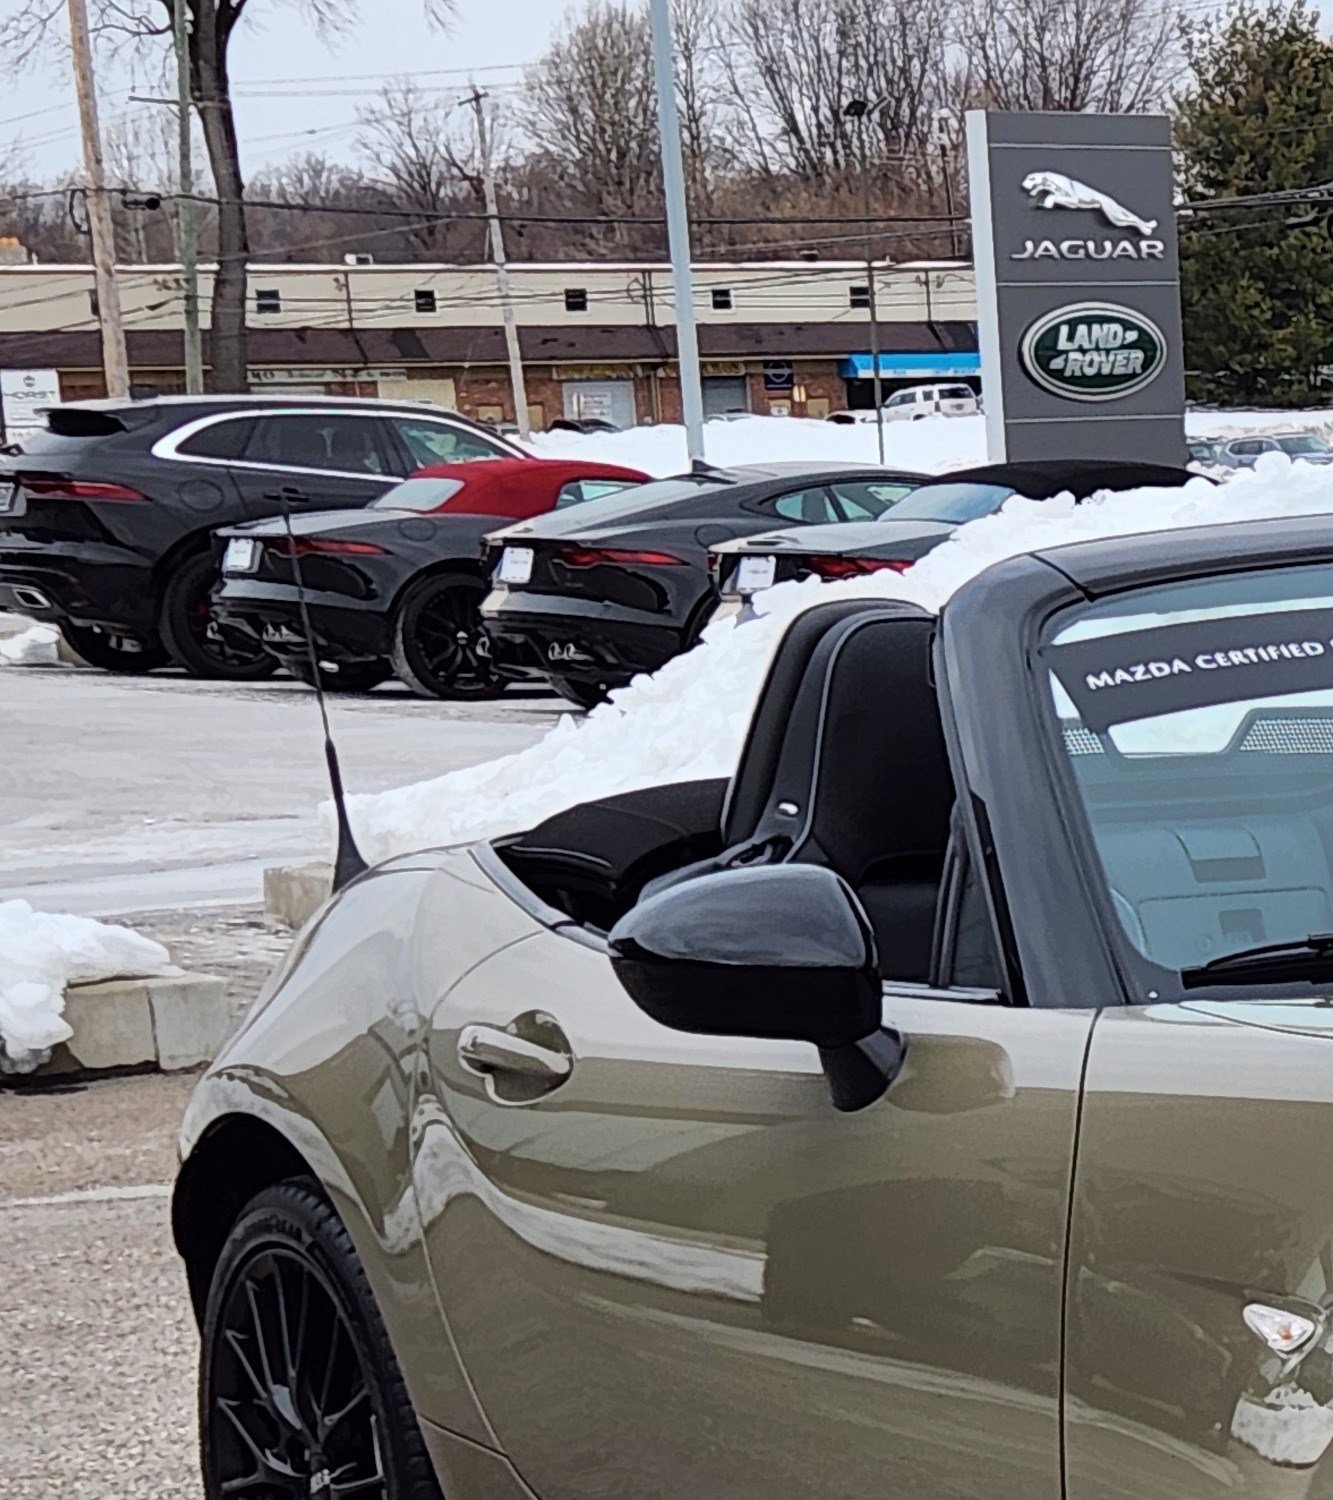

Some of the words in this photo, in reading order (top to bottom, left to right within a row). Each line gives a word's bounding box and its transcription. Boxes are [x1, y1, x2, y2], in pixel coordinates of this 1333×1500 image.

[1011, 240, 1164, 259] JAGUAR
[1057, 323, 1124, 350] LAND
[1064, 350, 1145, 377] ROVER
[1086, 657, 1192, 690] MAZDA
[1194, 641, 1325, 671] CERTIFIED
